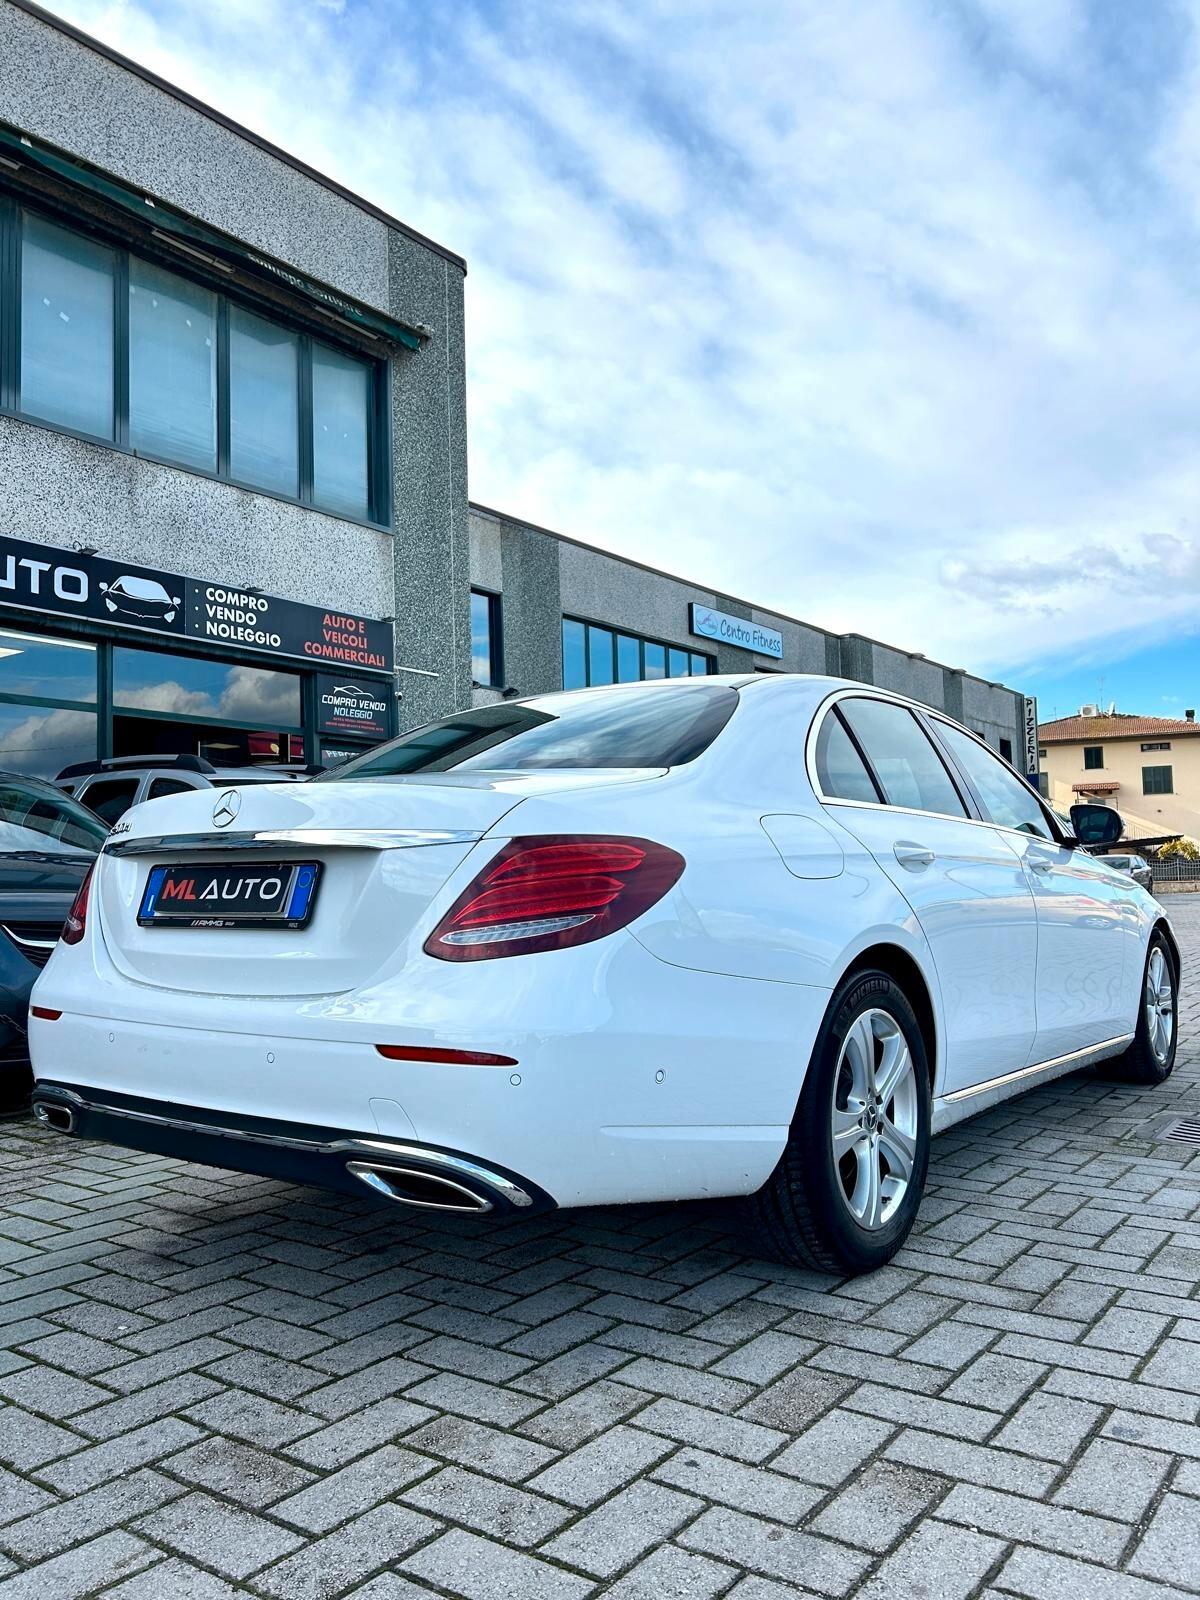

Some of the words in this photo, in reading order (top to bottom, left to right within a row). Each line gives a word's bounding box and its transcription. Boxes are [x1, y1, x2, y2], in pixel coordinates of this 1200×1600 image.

[206, 587, 268, 612] COMPRO
[205, 603, 257, 626] VENDO
[323, 614, 356, 631] AUTO
[358, 621, 365, 633] E
[206, 621, 281, 647] NOLEGGIO
[322, 628, 367, 648] VEICOLI
[720, 620, 750, 643] Centro
[752, 630, 781, 653] Fitness
[304, 641, 385, 667] COMMERCIALI
[322, 695, 357, 708] COMPRO
[359, 699, 386, 711] VENDO
[333, 706, 373, 720] NOLEGGIO
[1026, 699, 1035, 773] PIZZERIA
[162, 879, 197, 900] ML
[198, 877, 281, 900] AUTO
[850, 980, 889, 1007] MICHELIN
